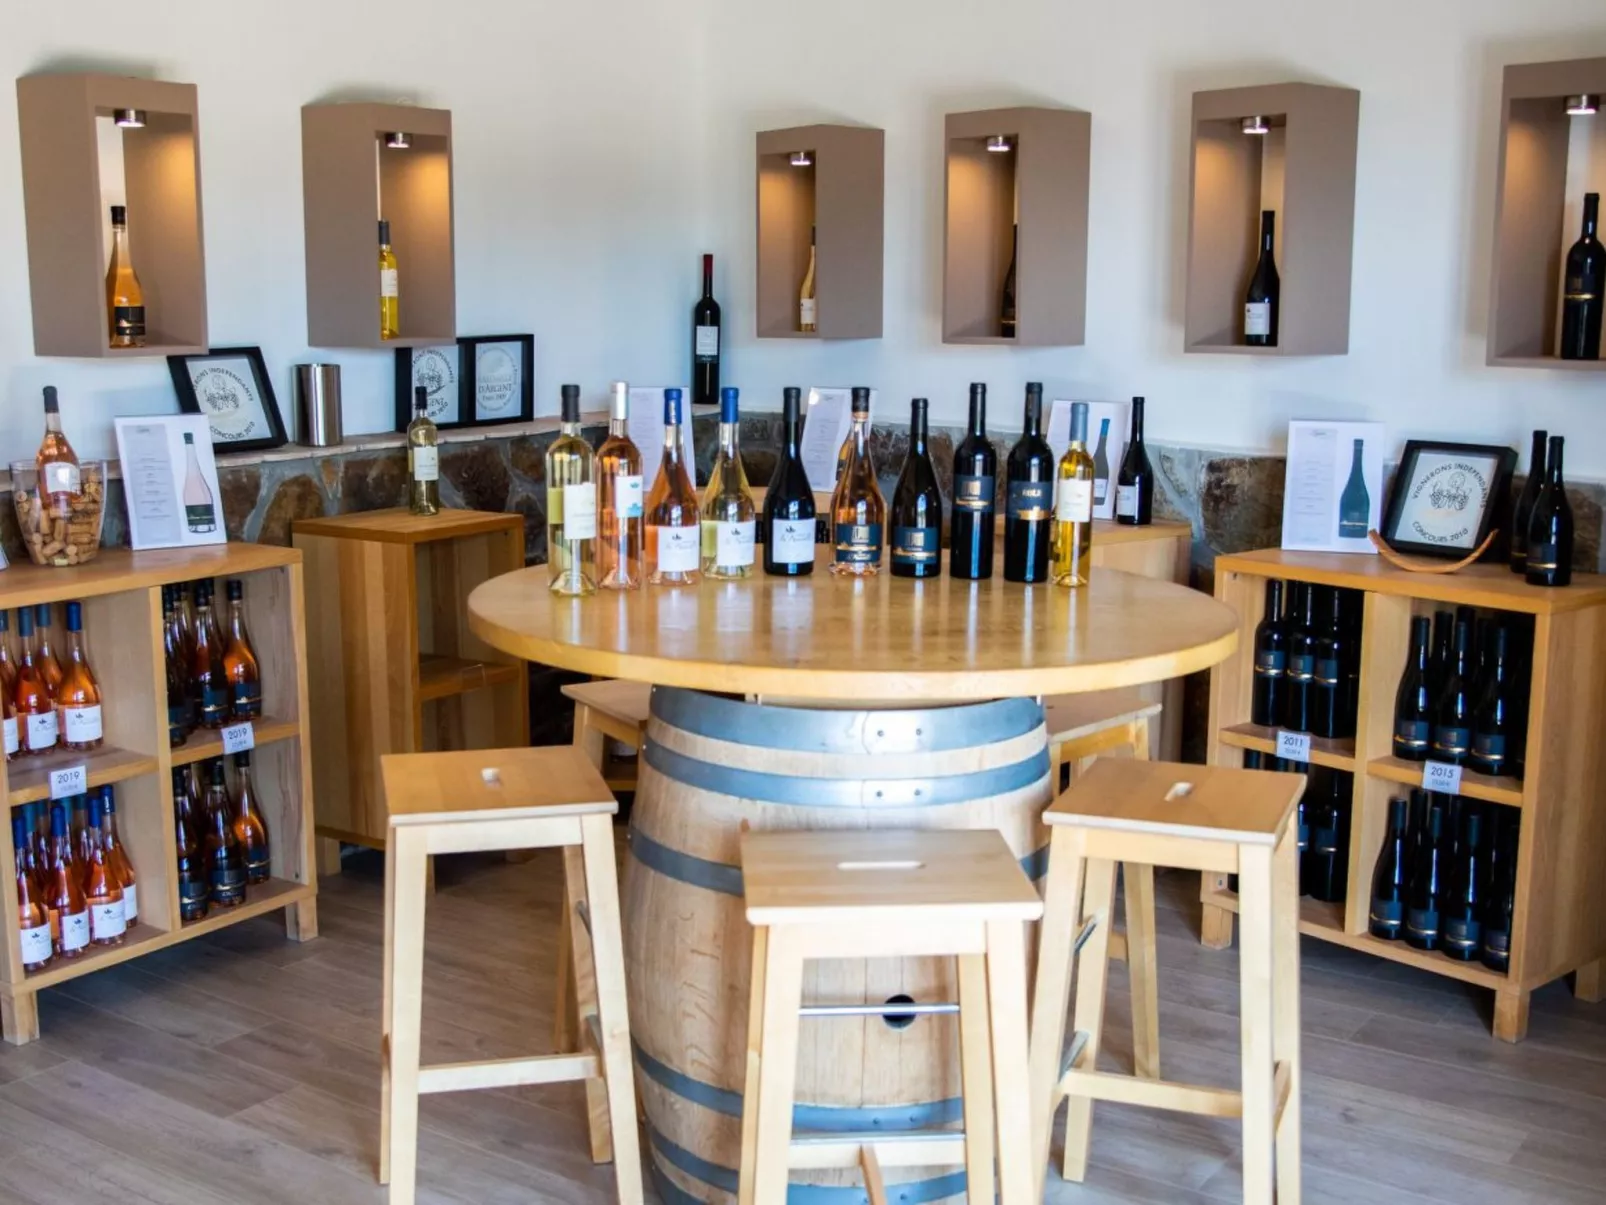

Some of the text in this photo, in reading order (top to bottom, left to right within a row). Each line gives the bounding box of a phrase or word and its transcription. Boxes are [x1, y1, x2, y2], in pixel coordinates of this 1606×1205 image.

[1412, 463, 1453, 499] VIGNERONS
[1412, 521, 1448, 542] CONCOURS
[228, 727, 248, 740] 2019
[1283, 735, 1303, 748] 2011
[57, 770, 81, 784] 2019
[1431, 765, 1454, 779] 2015
